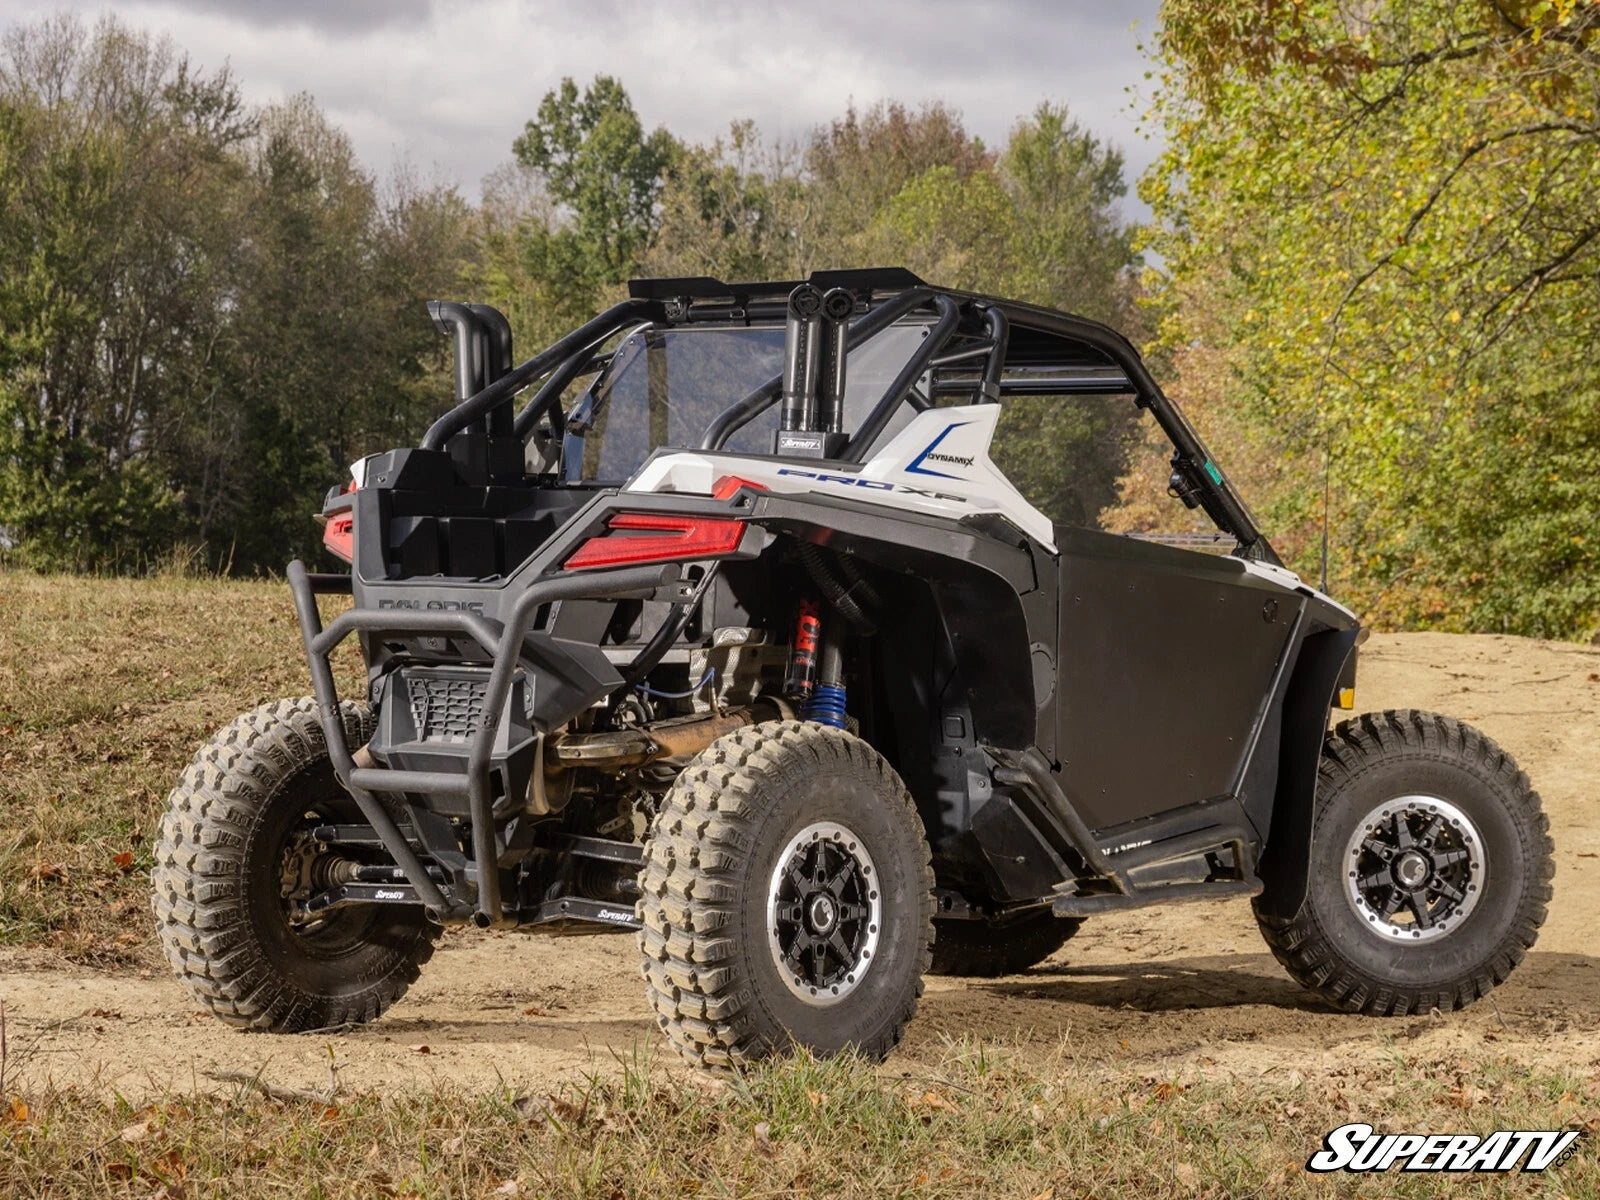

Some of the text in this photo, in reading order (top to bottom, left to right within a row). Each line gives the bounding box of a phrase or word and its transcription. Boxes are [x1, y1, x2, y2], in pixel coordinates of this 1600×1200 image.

[927, 453, 975, 468] DYNAMIX
[777, 468, 968, 503] PRO XP
